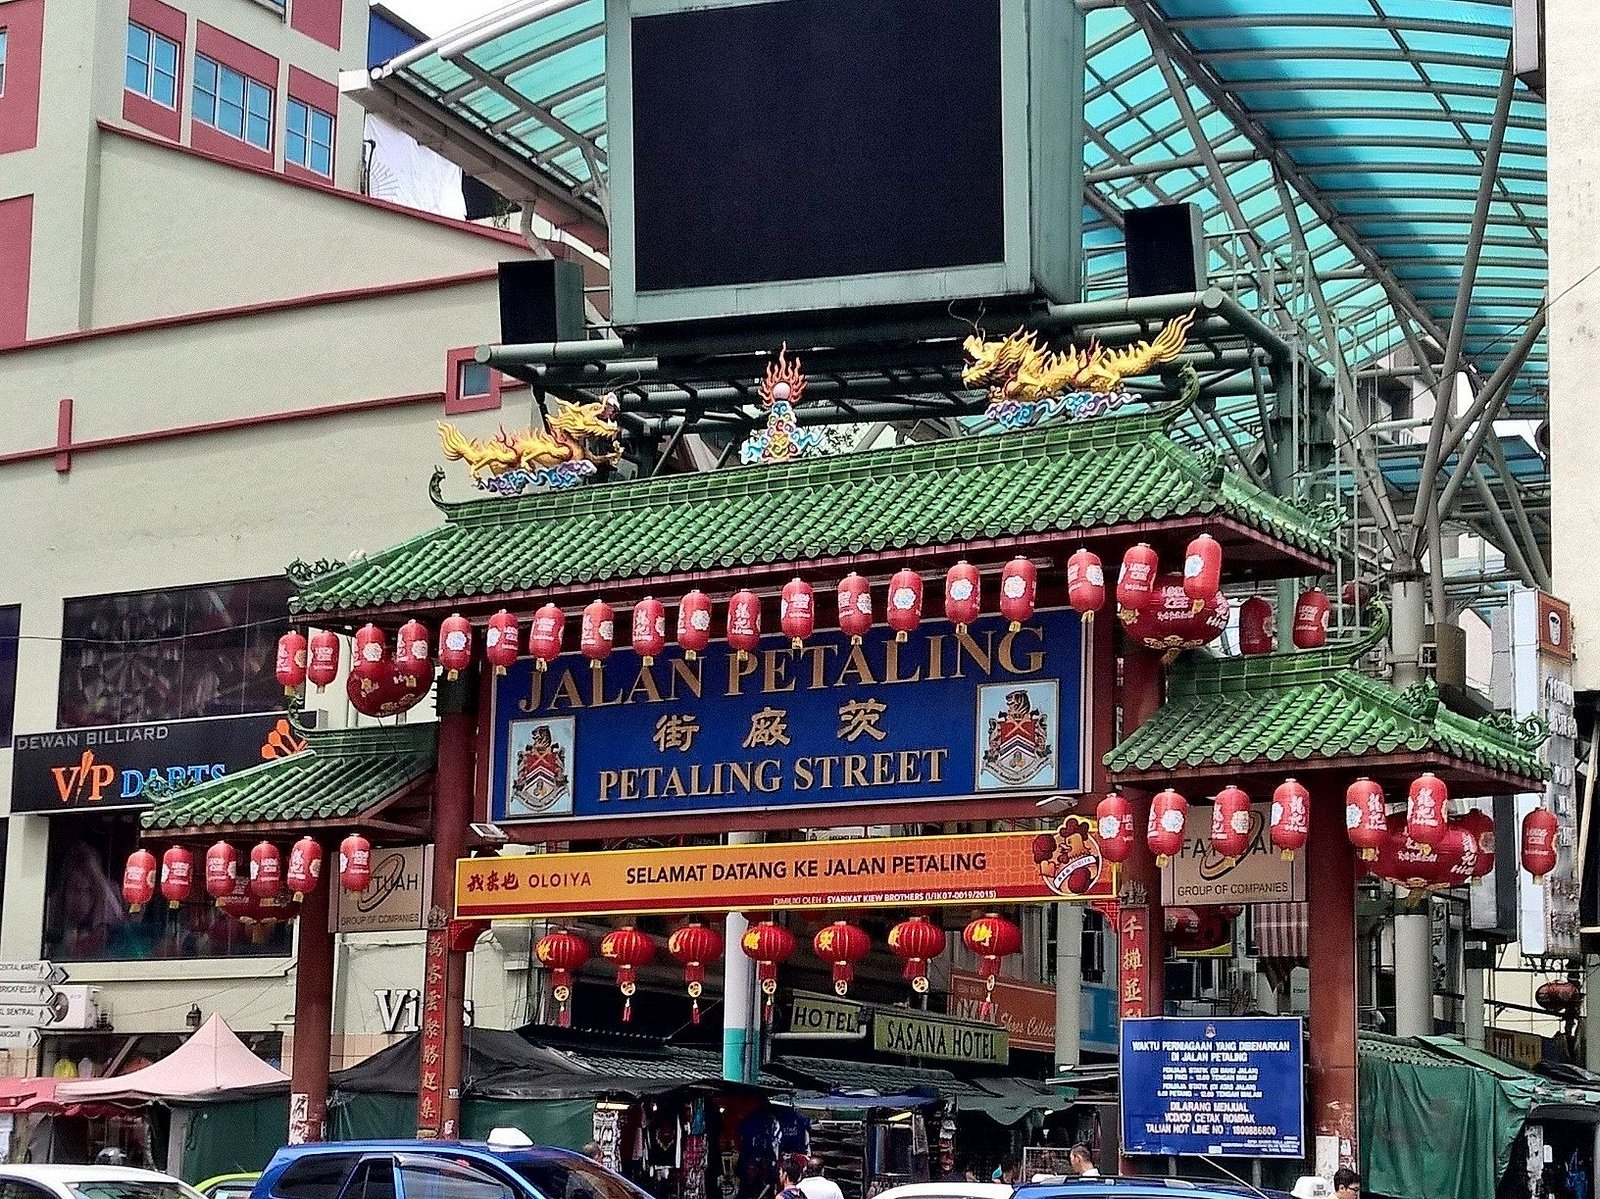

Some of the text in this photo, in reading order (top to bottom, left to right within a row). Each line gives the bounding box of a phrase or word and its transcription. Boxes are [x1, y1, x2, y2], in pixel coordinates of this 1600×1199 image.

[518, 626, 1049, 714] JALAN PETALING
[17, 726, 169, 750] DEWAN BILLIARD
[599, 758, 784, 803] PETALING
[793, 748, 949, 792] STREET
[626, 852, 987, 885] SELAMAT DATANG KE JALAN PETALING
[528, 871, 592, 889] OLOIYA
[1178, 881, 1288, 897] GROUP OF COMPANIES
[826, 895, 862, 904] SYARIKAT
[863, 894, 883, 903] KIEW
[884, 892, 924, 903] BROTHERS
[341, 913, 420, 926] GROUP OF COMPANIES
[793, 1006, 855, 1032] HOTEL
[887, 1020, 997, 1060] SASANA HOTEL
[1132, 1041, 1160, 1051] WAKTU
[1215, 1041, 1236, 1051] YANG
[1239, 1041, 1290, 1051] DIBENARKAN
[1170, 1052, 1248, 1062] DI JALAN PETALING
[1169, 1101, 1249, 1112] DILARANG MENJUAL
[1194, 1112, 1220, 1123] CETAK
[1223, 1112, 1256, 1124] ROMPAK
[1145, 1123, 1172, 1134] TALIAN
[1191, 1124, 1210, 1134] LINE
[1212, 1124, 1224, 1134] NO
